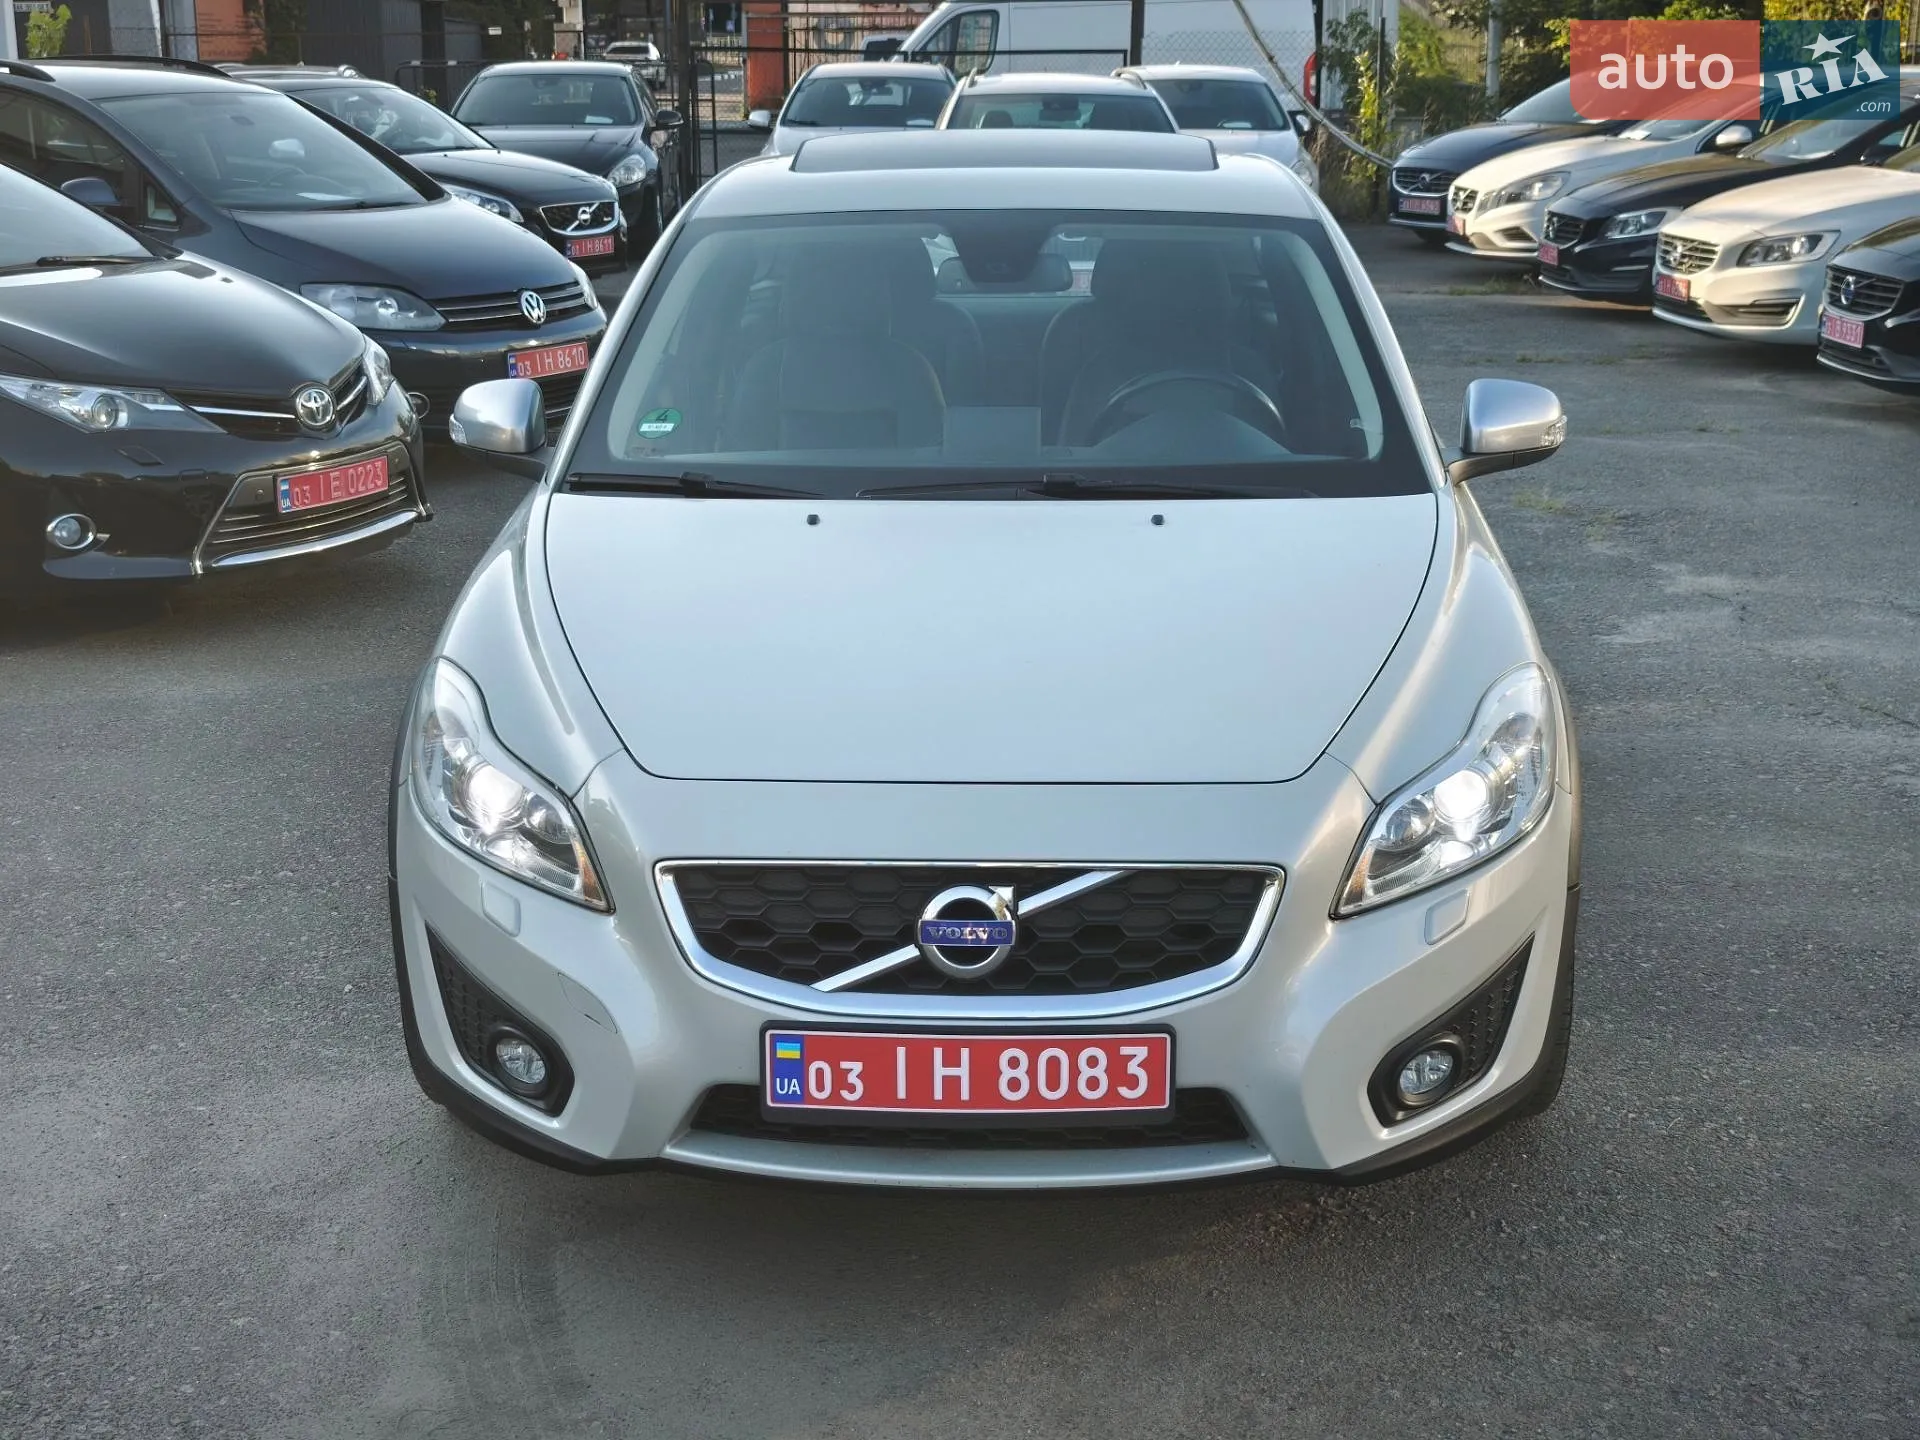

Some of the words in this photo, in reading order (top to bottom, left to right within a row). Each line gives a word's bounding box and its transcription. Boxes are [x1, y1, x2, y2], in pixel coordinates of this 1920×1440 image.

[557, 346, 585, 369] 8610
[293, 485, 311, 506] 03
[347, 460, 384, 495] 0223
[926, 926, 1008, 940] VOLVO
[808, 1060, 865, 1101] 03
[998, 1046, 1149, 1101] 8083
[776, 1077, 800, 1095] UA
